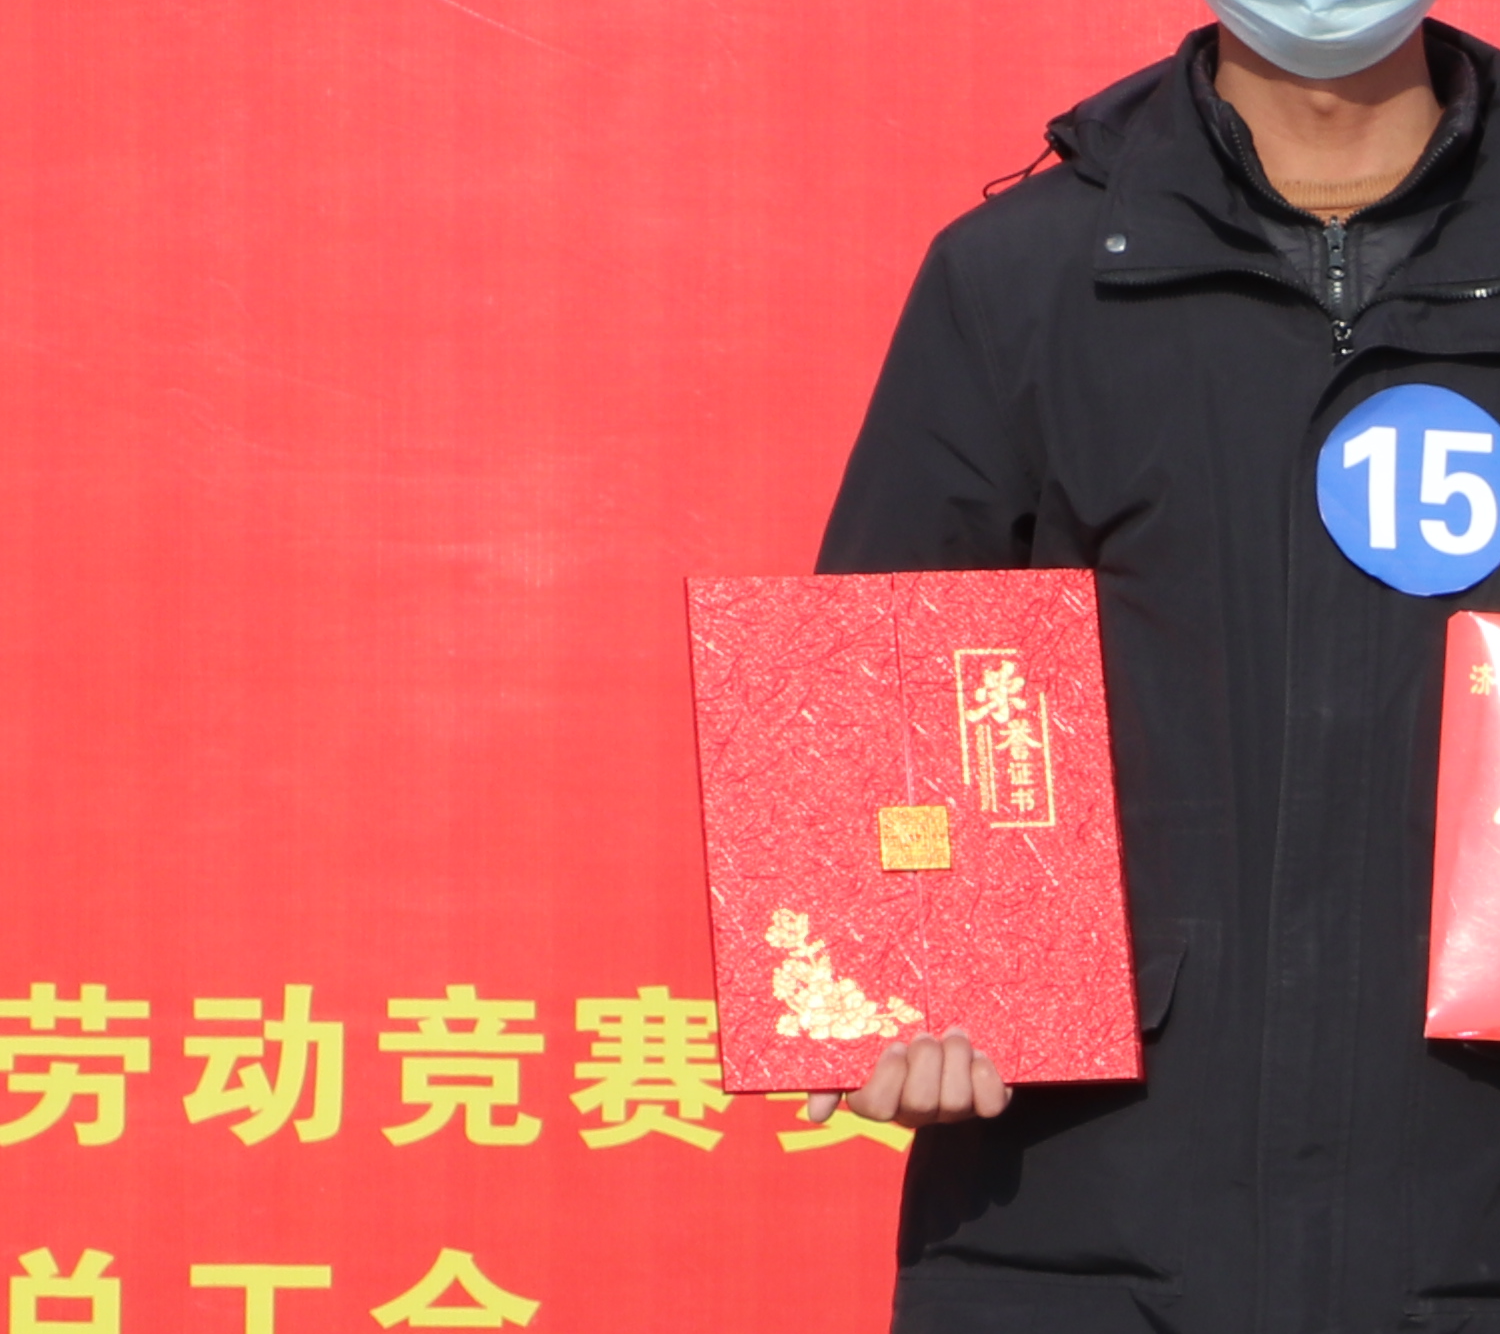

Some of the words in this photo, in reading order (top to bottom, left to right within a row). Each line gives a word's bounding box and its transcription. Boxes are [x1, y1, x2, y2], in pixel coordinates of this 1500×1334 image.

[1343, 426, 1498, 555] 15
[0, 983, 915, 1152] 劳动竞赛
